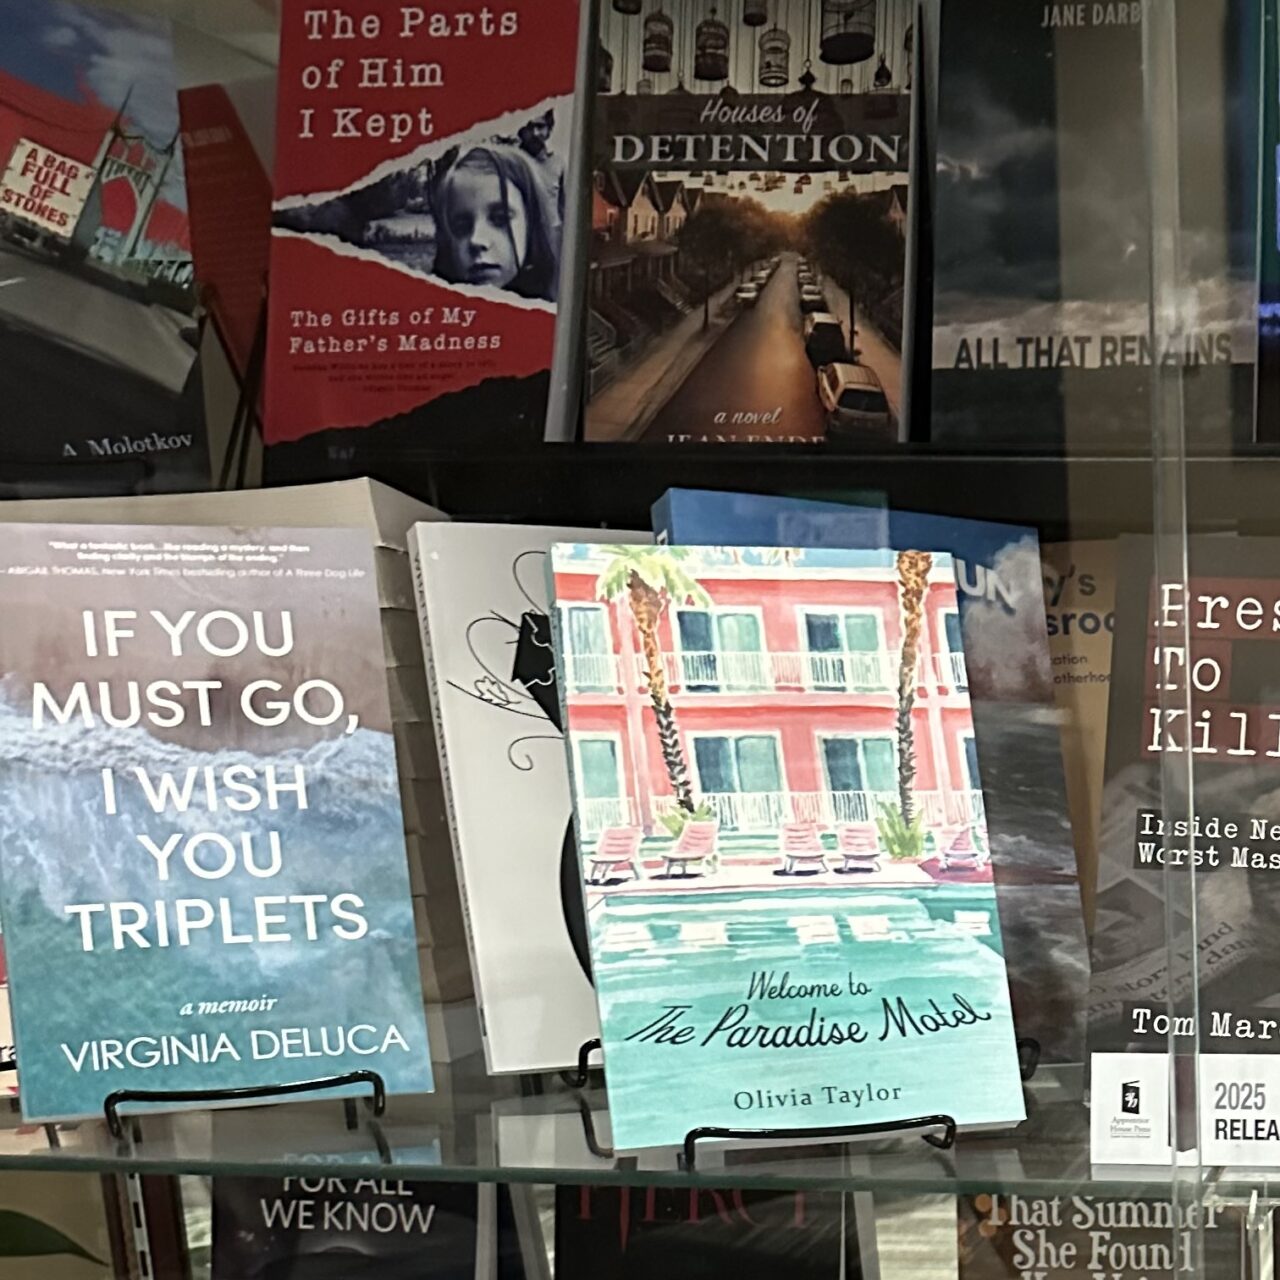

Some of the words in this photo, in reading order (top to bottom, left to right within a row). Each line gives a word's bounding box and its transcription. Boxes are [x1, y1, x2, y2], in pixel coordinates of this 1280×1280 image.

[304, 8, 381, 39] The
[400, 6, 519, 37] Parts
[301, 58, 346, 91] of
[358, 59, 445, 88] Him
[298, 110, 315, 138] I
[333, 107, 435, 142] Kept
[700, 99, 785, 124] Houses
[793, 98, 818, 134] of
[26, 147, 38, 161] A
[43, 153, 80, 180] BAG
[612, 133, 902, 167] DETENTION
[28, 182, 55, 202] OF
[290, 310, 333, 328] The
[342, 309, 400, 327] Gifts
[409, 308, 434, 325] of
[442, 308, 476, 328] My
[289, 335, 388, 355] Father's
[397, 333, 502, 352] Madness
[714, 410, 727, 425] a
[731, 405, 783, 425] novel
[82, 609, 137, 658] IF
[151, 609, 294, 658] YOU
[31, 680, 223, 730] MUST
[240, 679, 360, 735] GO,
[101, 767, 117, 815] I
[135, 765, 308, 815] WISH
[137, 831, 283, 882] YOU
[64, 893, 369, 952] TRIPLETS
[747, 971, 843, 999] Welcome
[847, 971, 872, 997] to
[180, 1003, 193, 1016] a
[198, 994, 279, 1016] memoir
[1132, 1008, 1198, 1038] Tom
[60, 1032, 241, 1073] VIRGINIA
[250, 1024, 411, 1060] DELUCA
[733, 1090, 813, 1110] Olivia
[821, 1085, 903, 1106] Taylor
[1214, 1082, 1266, 1111] 2025
[260, 1198, 317, 1231] WE
[322, 1201, 436, 1234] KNOW
